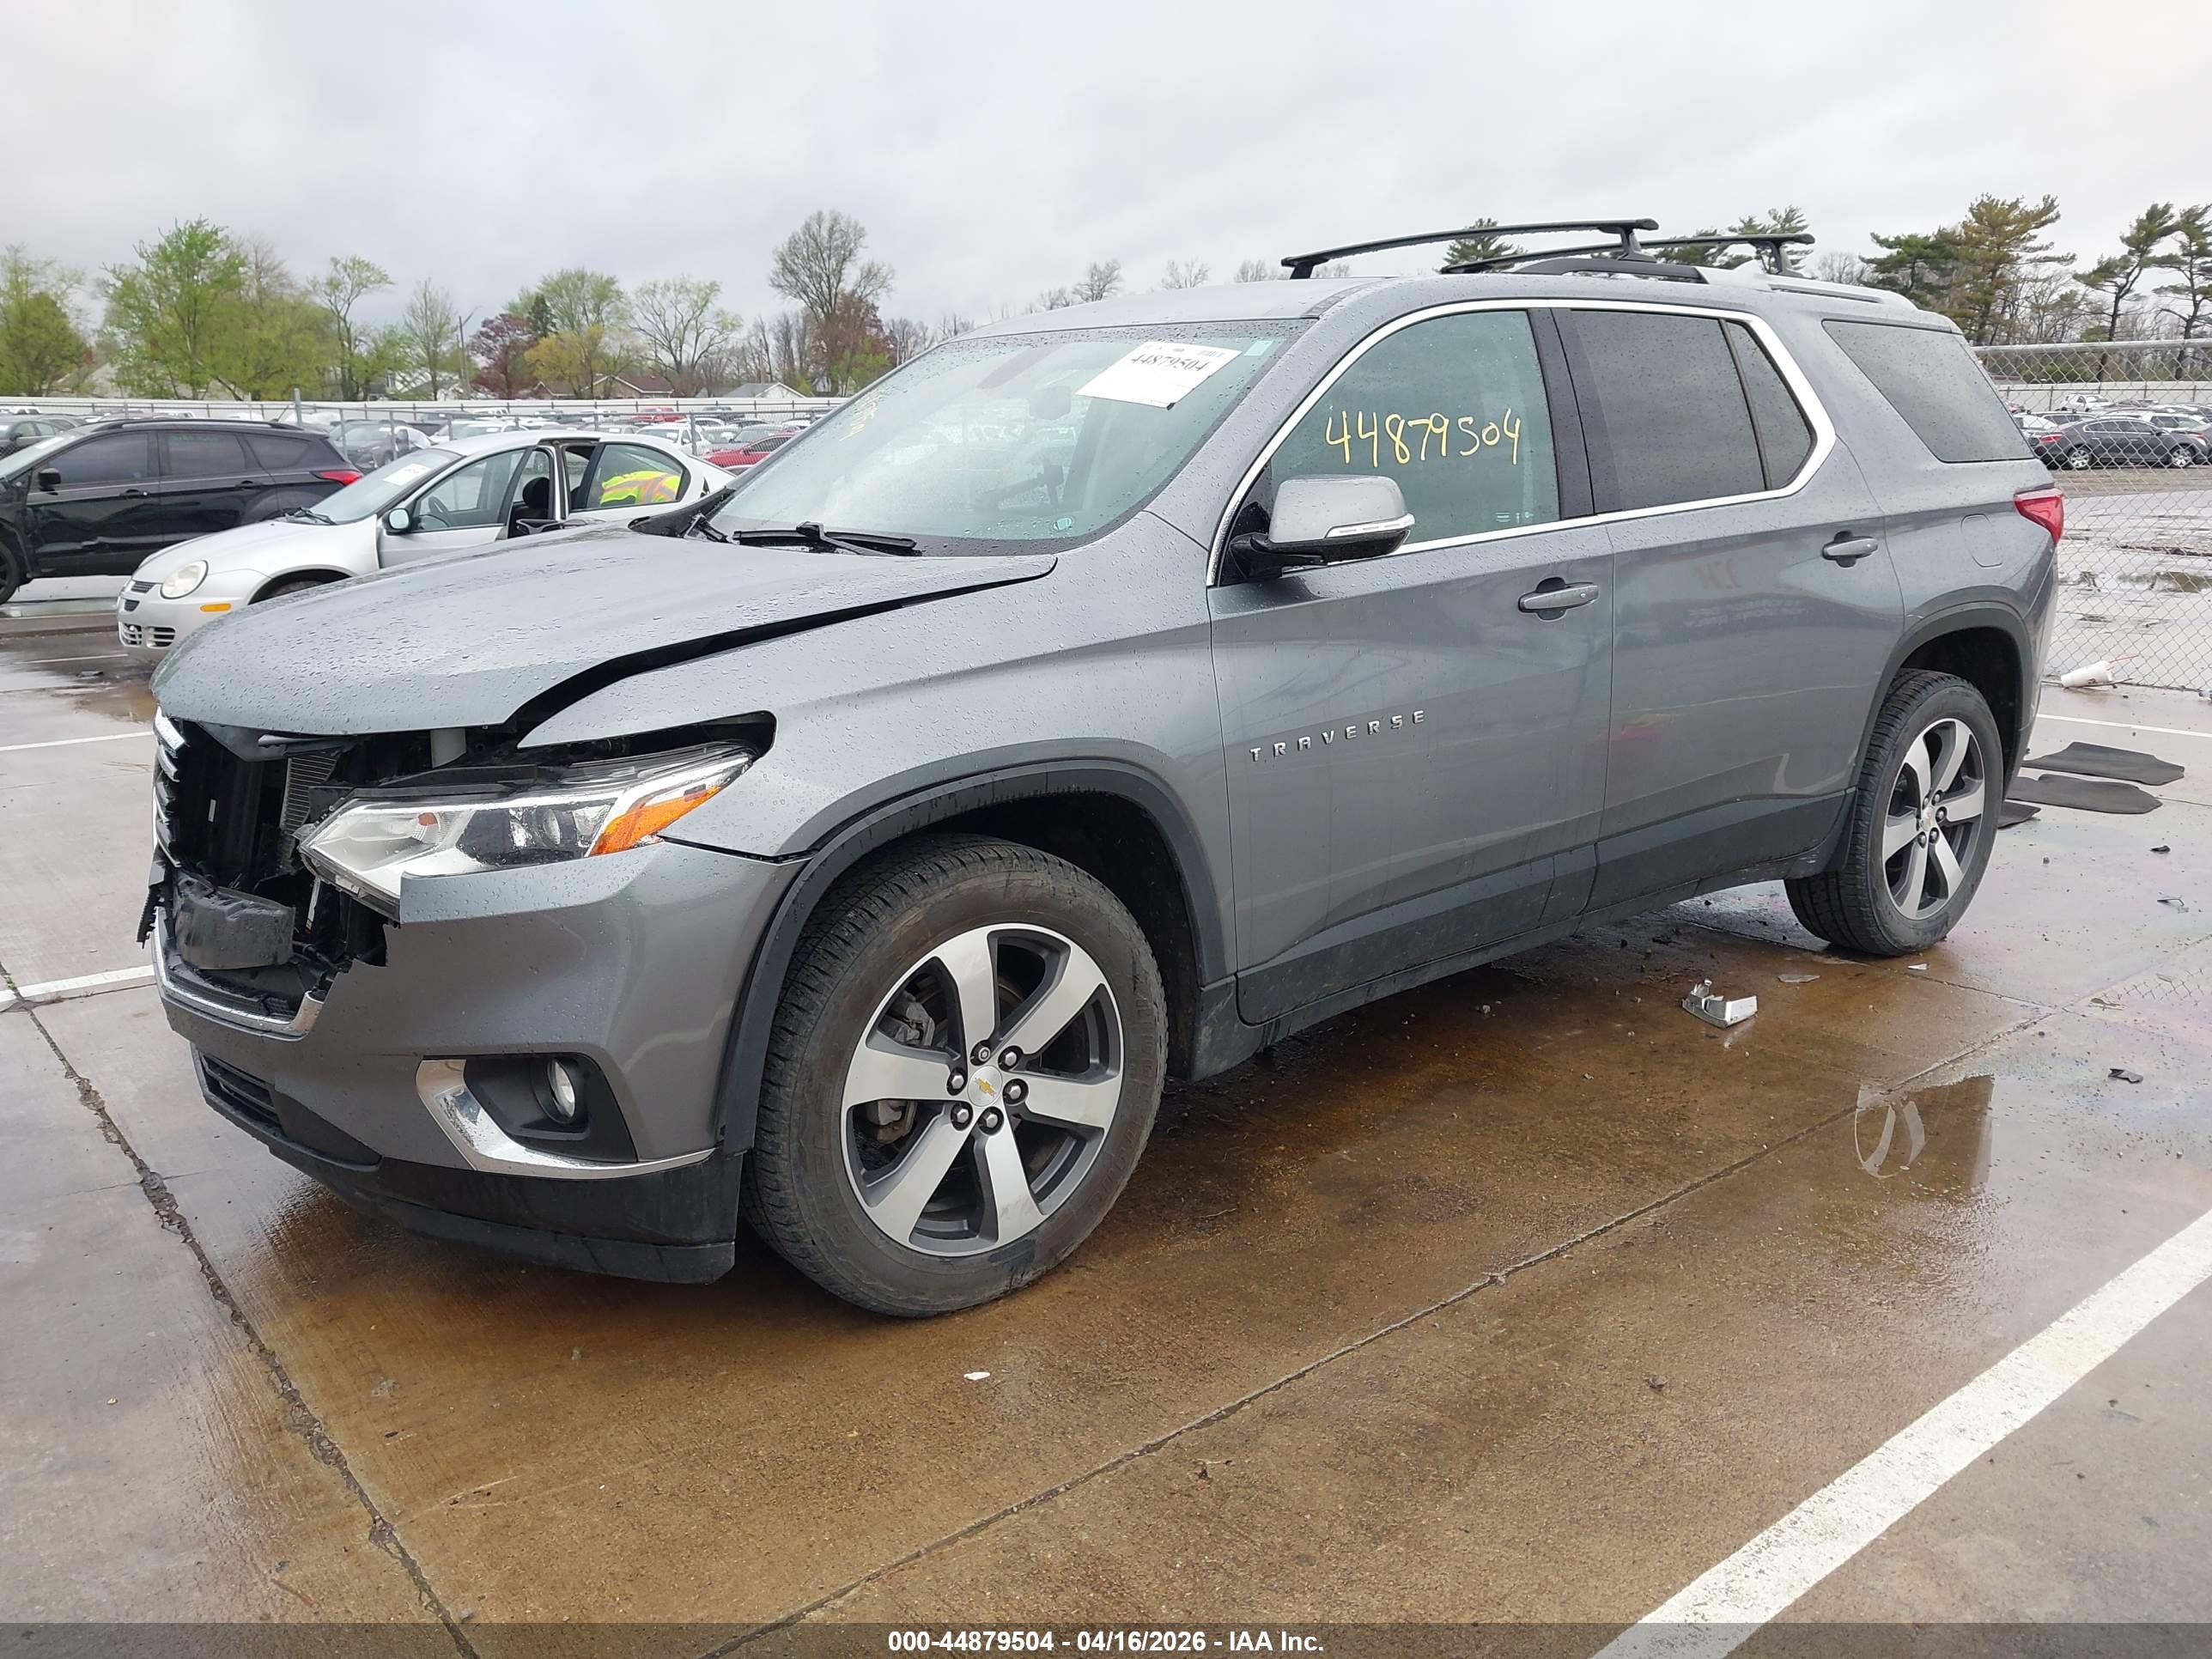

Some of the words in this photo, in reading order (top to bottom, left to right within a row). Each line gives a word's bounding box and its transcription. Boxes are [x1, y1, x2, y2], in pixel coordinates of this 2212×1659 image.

[1130, 354, 1210, 371] 44879504
[1325, 408, 1522, 468] 44879504
[1249, 709, 1425, 763] TRAVERSE
